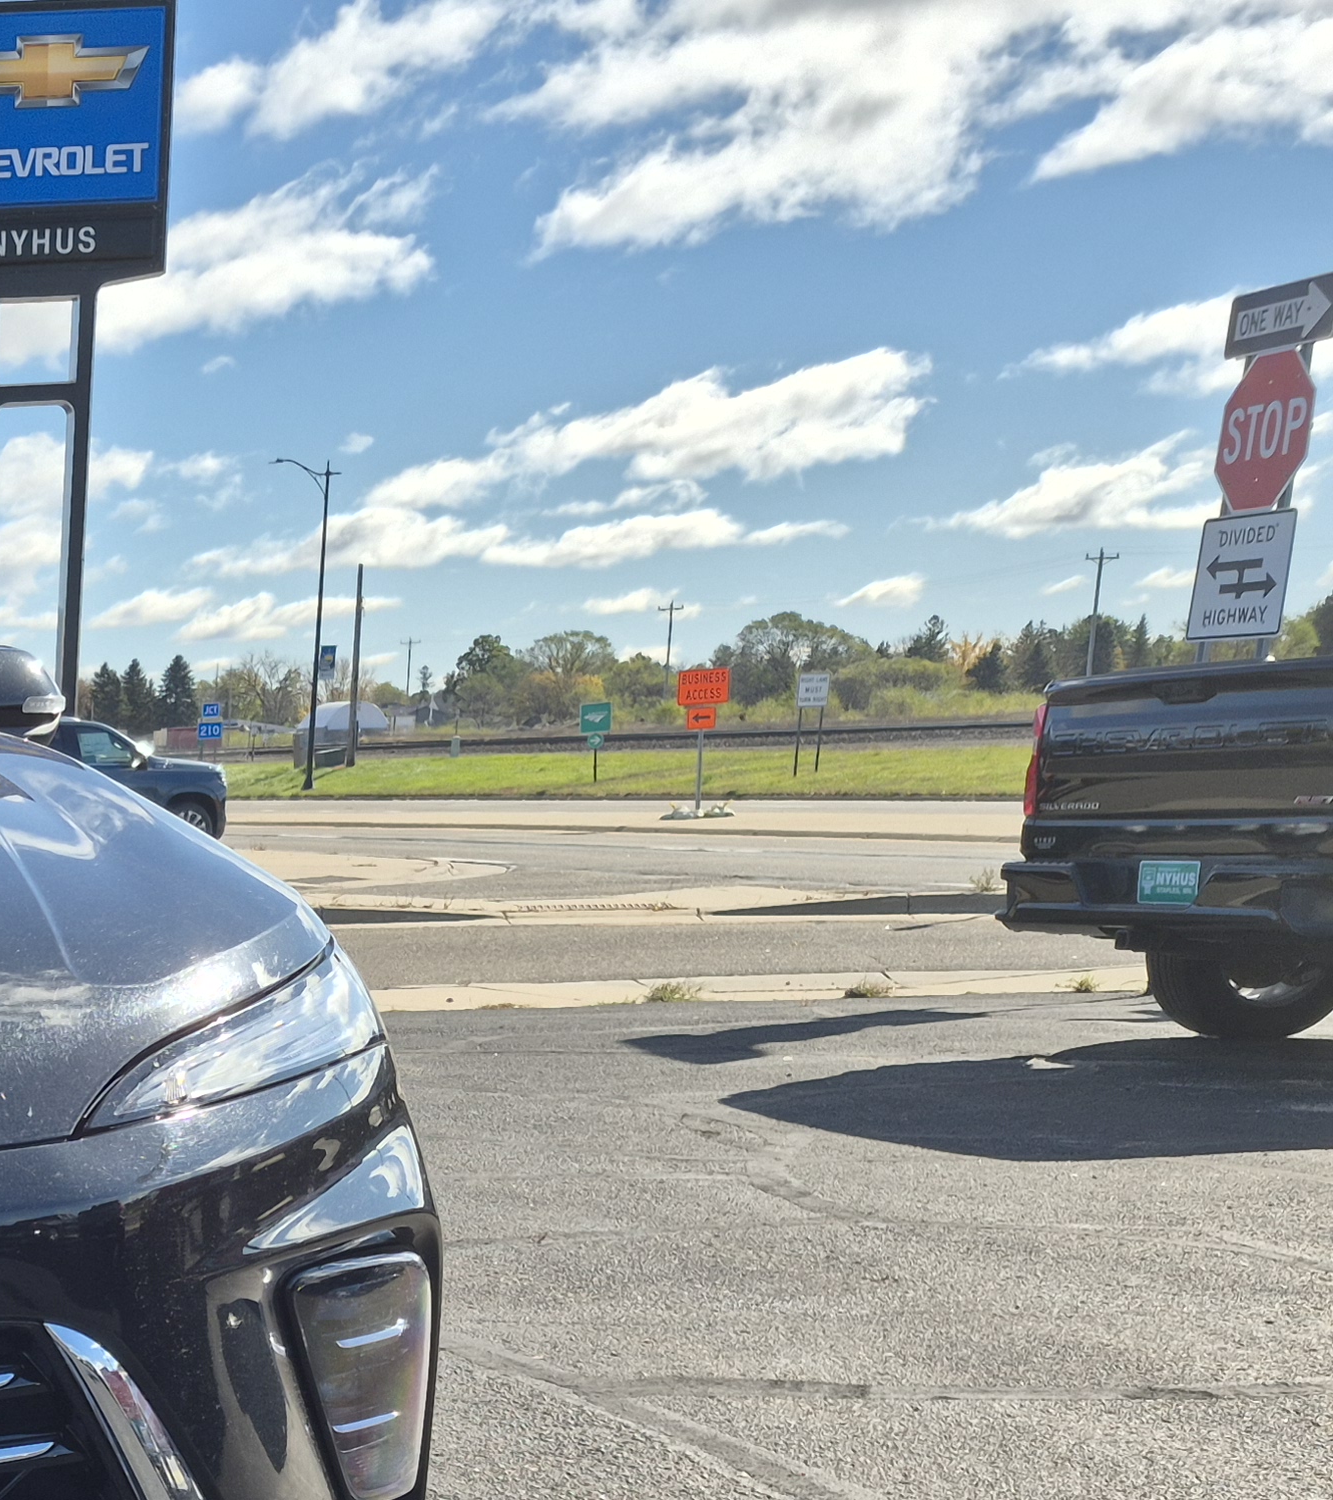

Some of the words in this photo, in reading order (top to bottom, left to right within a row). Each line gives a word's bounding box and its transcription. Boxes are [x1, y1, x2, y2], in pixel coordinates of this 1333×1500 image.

[1239, 309, 1269, 336] ONE
[1273, 299, 1304, 327] WAY
[1223, 397, 1307, 465] STOP
[1219, 525, 1276, 548] DIVIDED
[1202, 605, 1268, 627] HIGHWAY
[682, 671, 727, 685] BUSINESS
[686, 687, 722, 700] ACCESS
[204, 705, 218, 715] JCT
[200, 725, 220, 736] 210
[1039, 802, 1100, 811] SILVERADO
[1156, 872, 1196, 886] NYHUS
